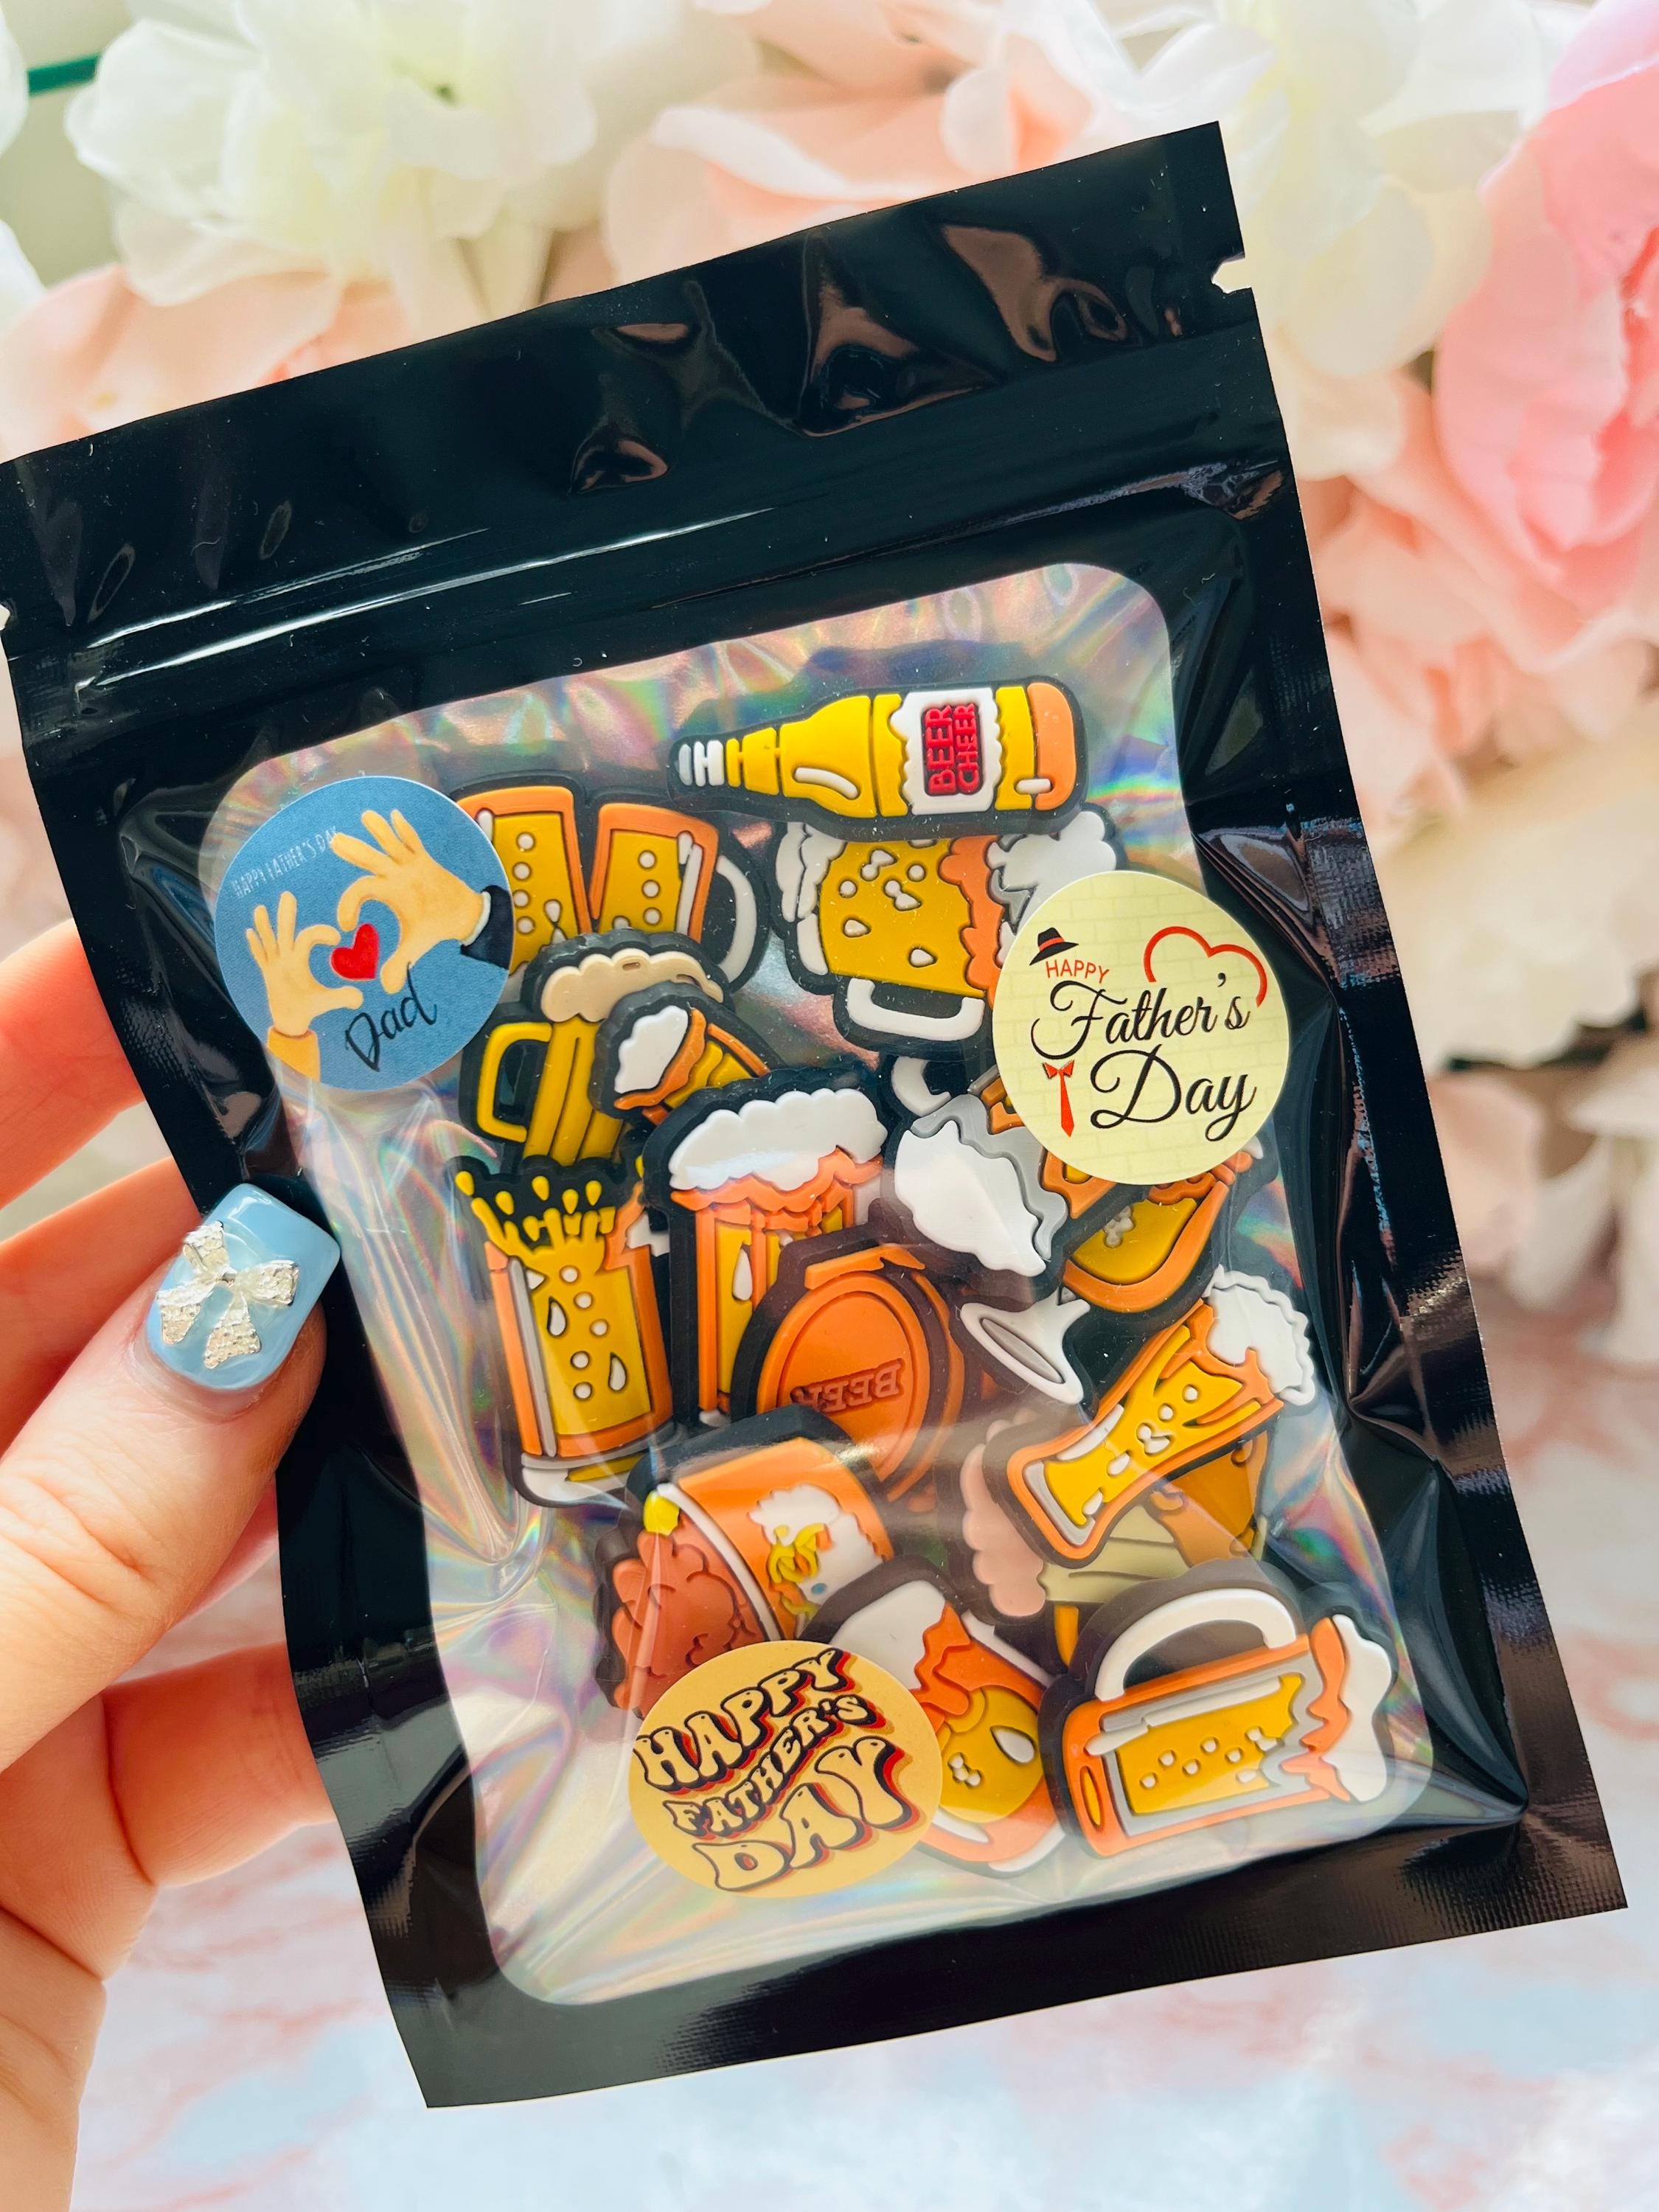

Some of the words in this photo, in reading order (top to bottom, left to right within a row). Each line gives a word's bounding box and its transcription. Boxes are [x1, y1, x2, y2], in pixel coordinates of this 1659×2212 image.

[924, 705, 957, 796] BEER
[952, 703, 981, 794] CHEER
[230, 867, 267, 899] HAPPY
[265, 839, 317, 880] FATHER'S
[344, 961, 437, 1073] Dad
[1031, 972, 1251, 1060] Father's
[1045, 959, 1110, 984] HAPPY
[1090, 1043, 1257, 1142] Day
[633, 1647, 855, 1794] HAPPY
[663, 1694, 888, 1838] FATHER'S
[692, 1735, 914, 1891] DAY
